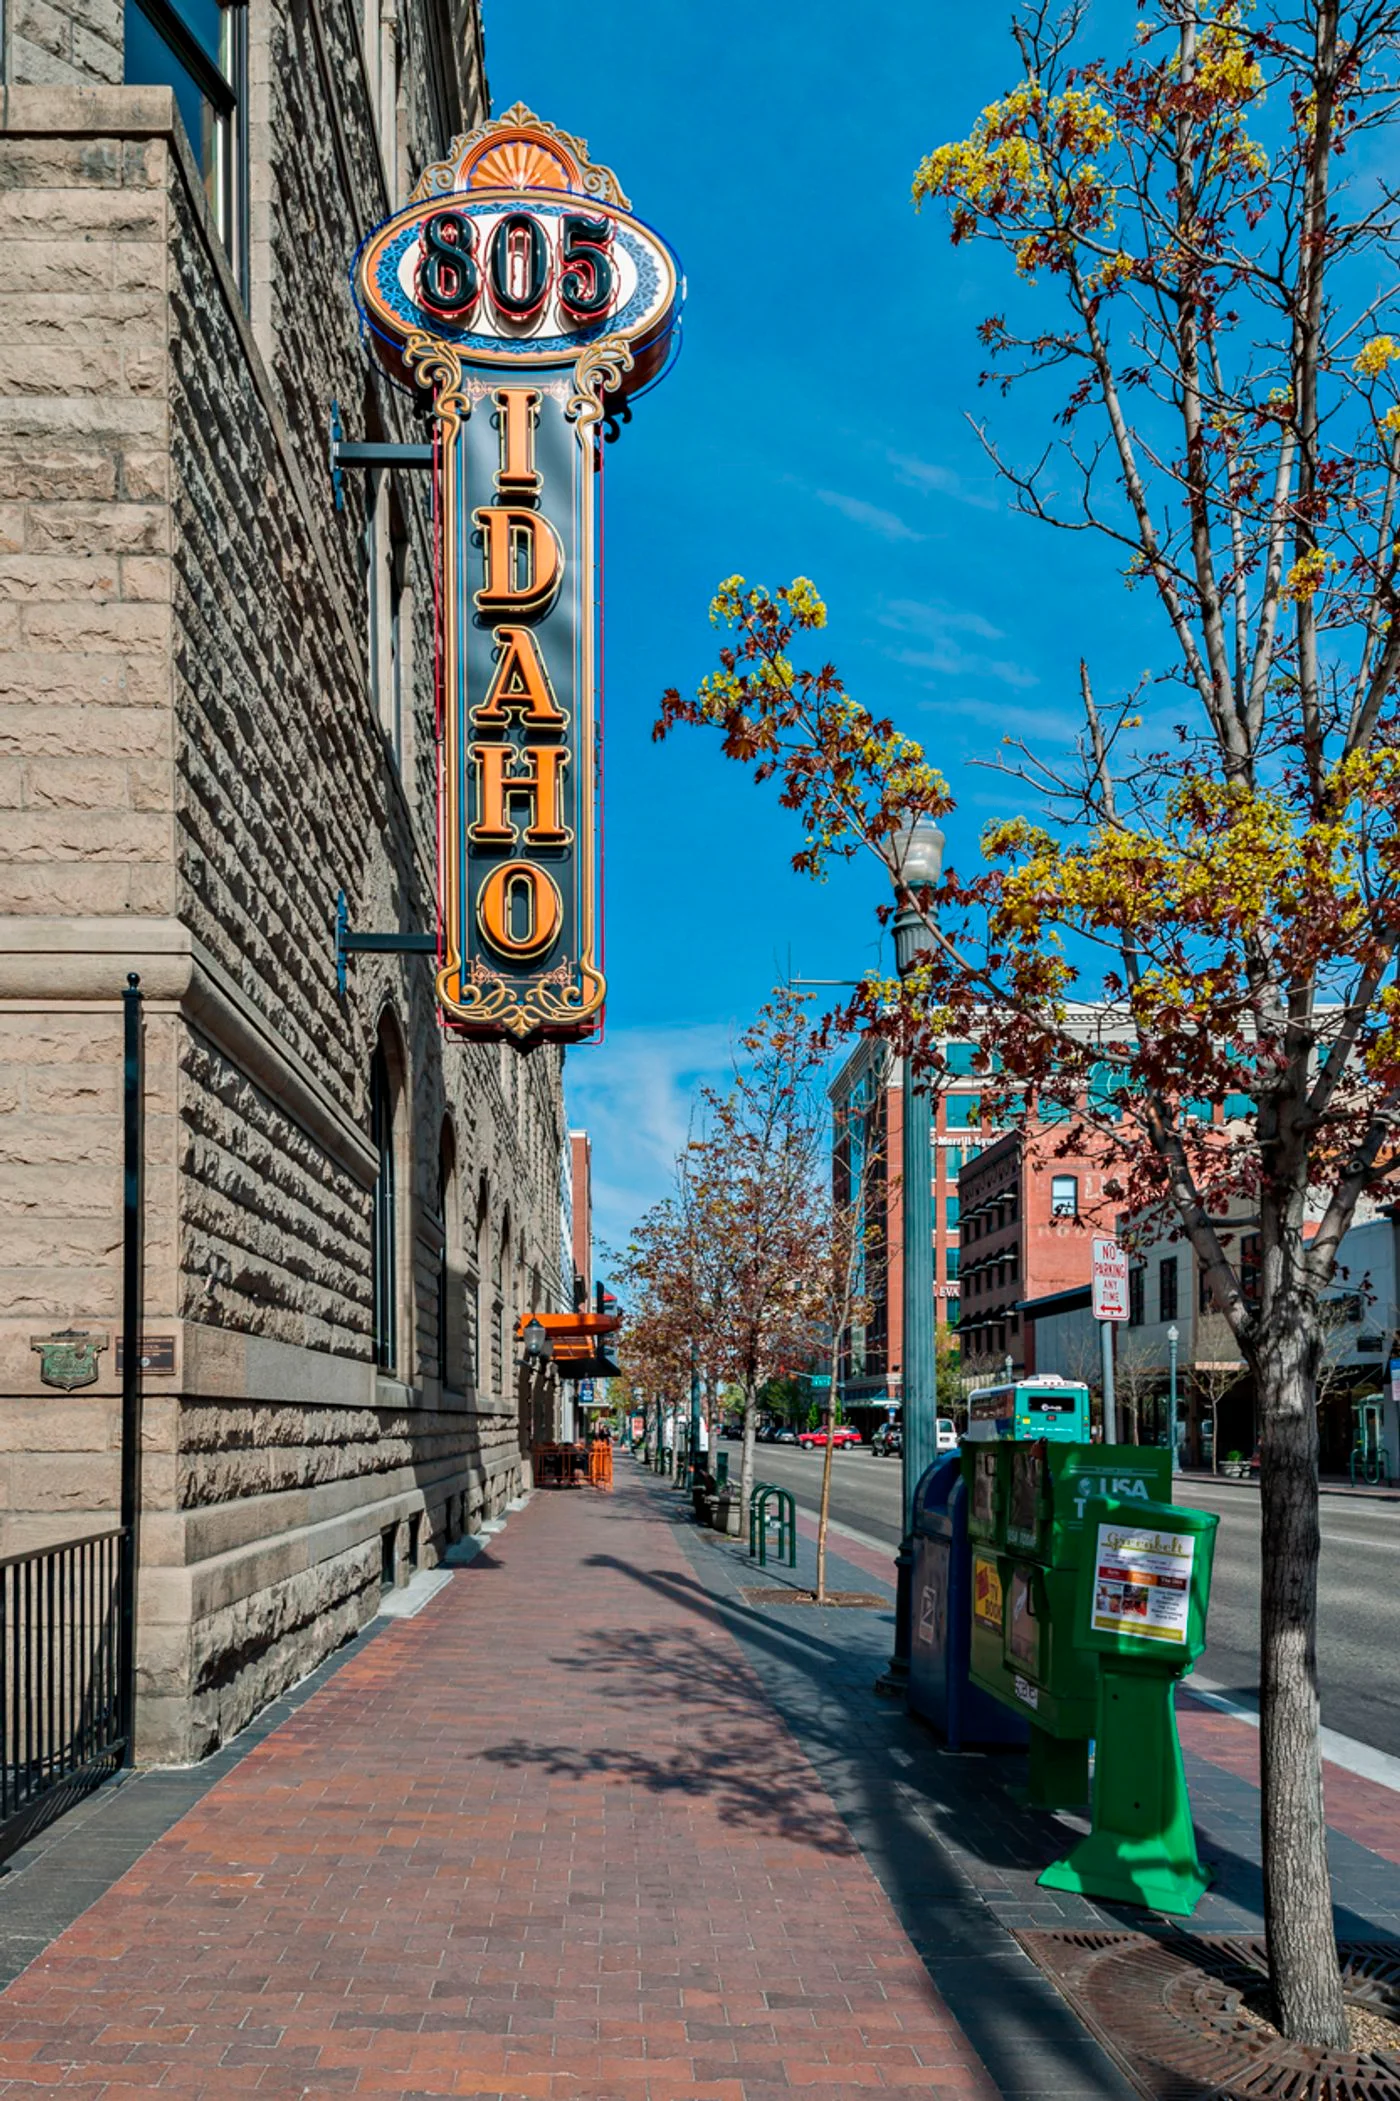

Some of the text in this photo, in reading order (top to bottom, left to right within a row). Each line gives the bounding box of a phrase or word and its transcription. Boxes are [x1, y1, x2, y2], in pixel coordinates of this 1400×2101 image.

[416, 209, 621, 319] 805
[468, 386, 574, 960] IDAHO
[1102, 1245, 1116, 1260] NO
[1095, 1262, 1124, 1278] PARKING
[1103, 1279, 1118, 1290] ANY
[1102, 1290, 1119, 1302] TIME
[1100, 1477, 1149, 1500] USA
